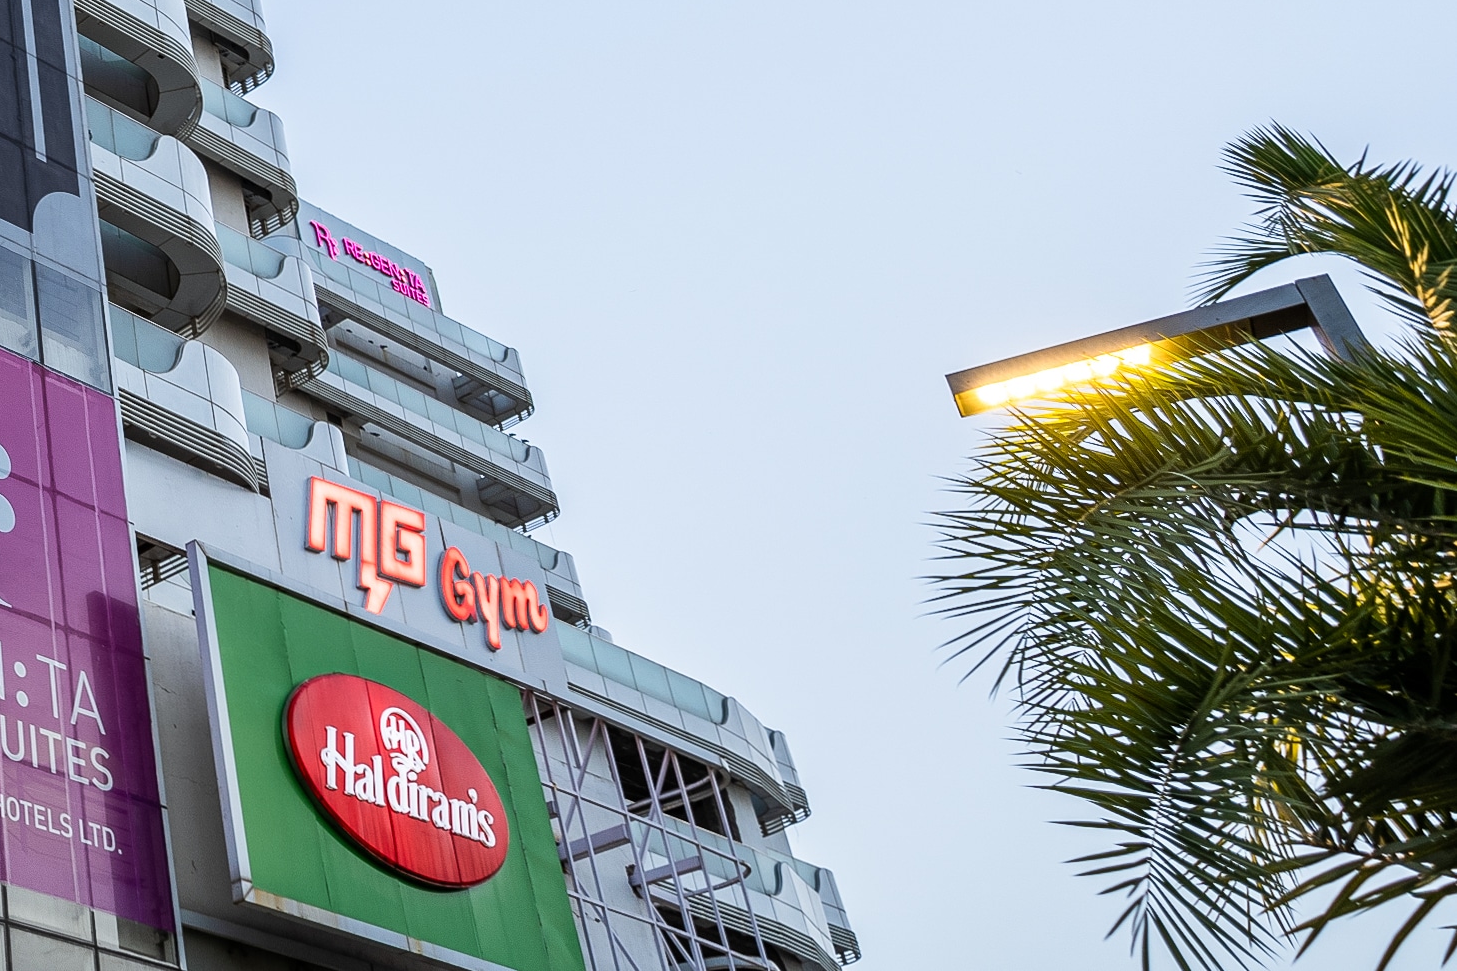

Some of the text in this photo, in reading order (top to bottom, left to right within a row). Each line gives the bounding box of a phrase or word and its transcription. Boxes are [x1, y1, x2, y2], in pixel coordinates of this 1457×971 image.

[391, 279, 431, 307] SUITES
[305, 476, 548, 651] MG Gym
[320, 725, 496, 848] Haldiram's
[78, 819, 123, 855] LTD.
